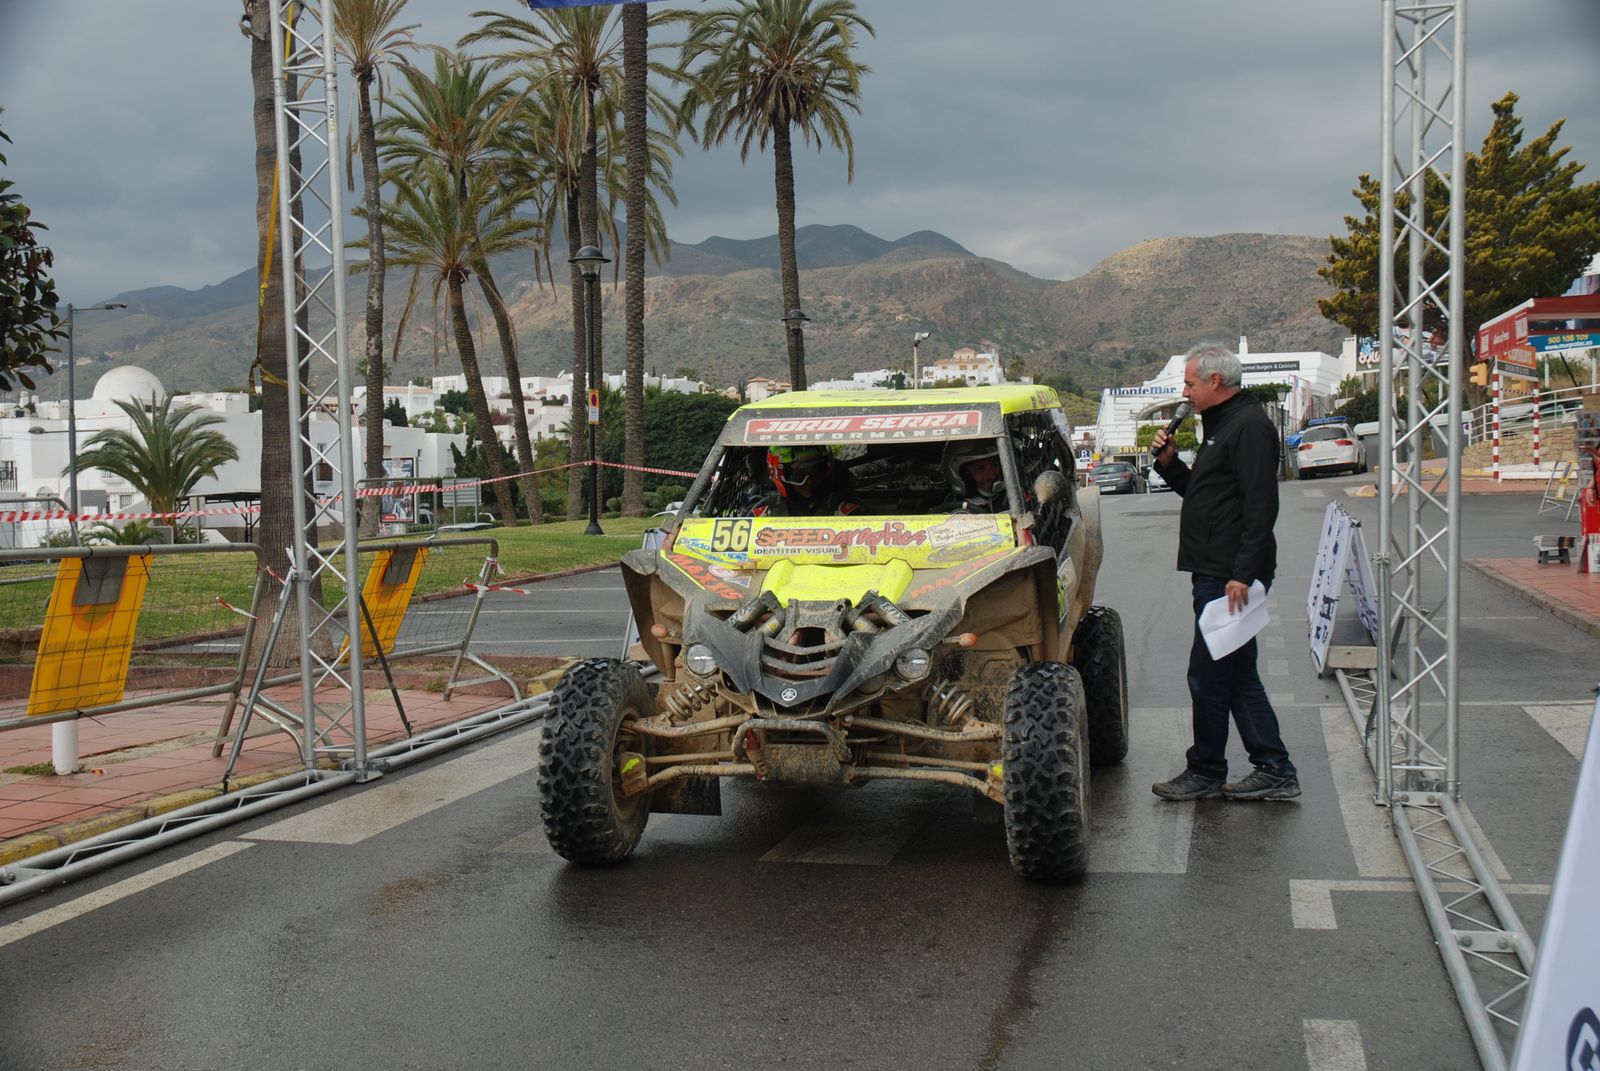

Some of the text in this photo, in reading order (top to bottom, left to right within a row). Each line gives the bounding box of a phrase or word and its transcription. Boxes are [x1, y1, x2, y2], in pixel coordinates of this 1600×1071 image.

[757, 413, 970, 433] JORDI SERRA
[759, 427, 962, 442] PERFORMANCE
[712, 519, 751, 553] 56
[753, 547, 841, 556] IDENTITAT VISUAL
